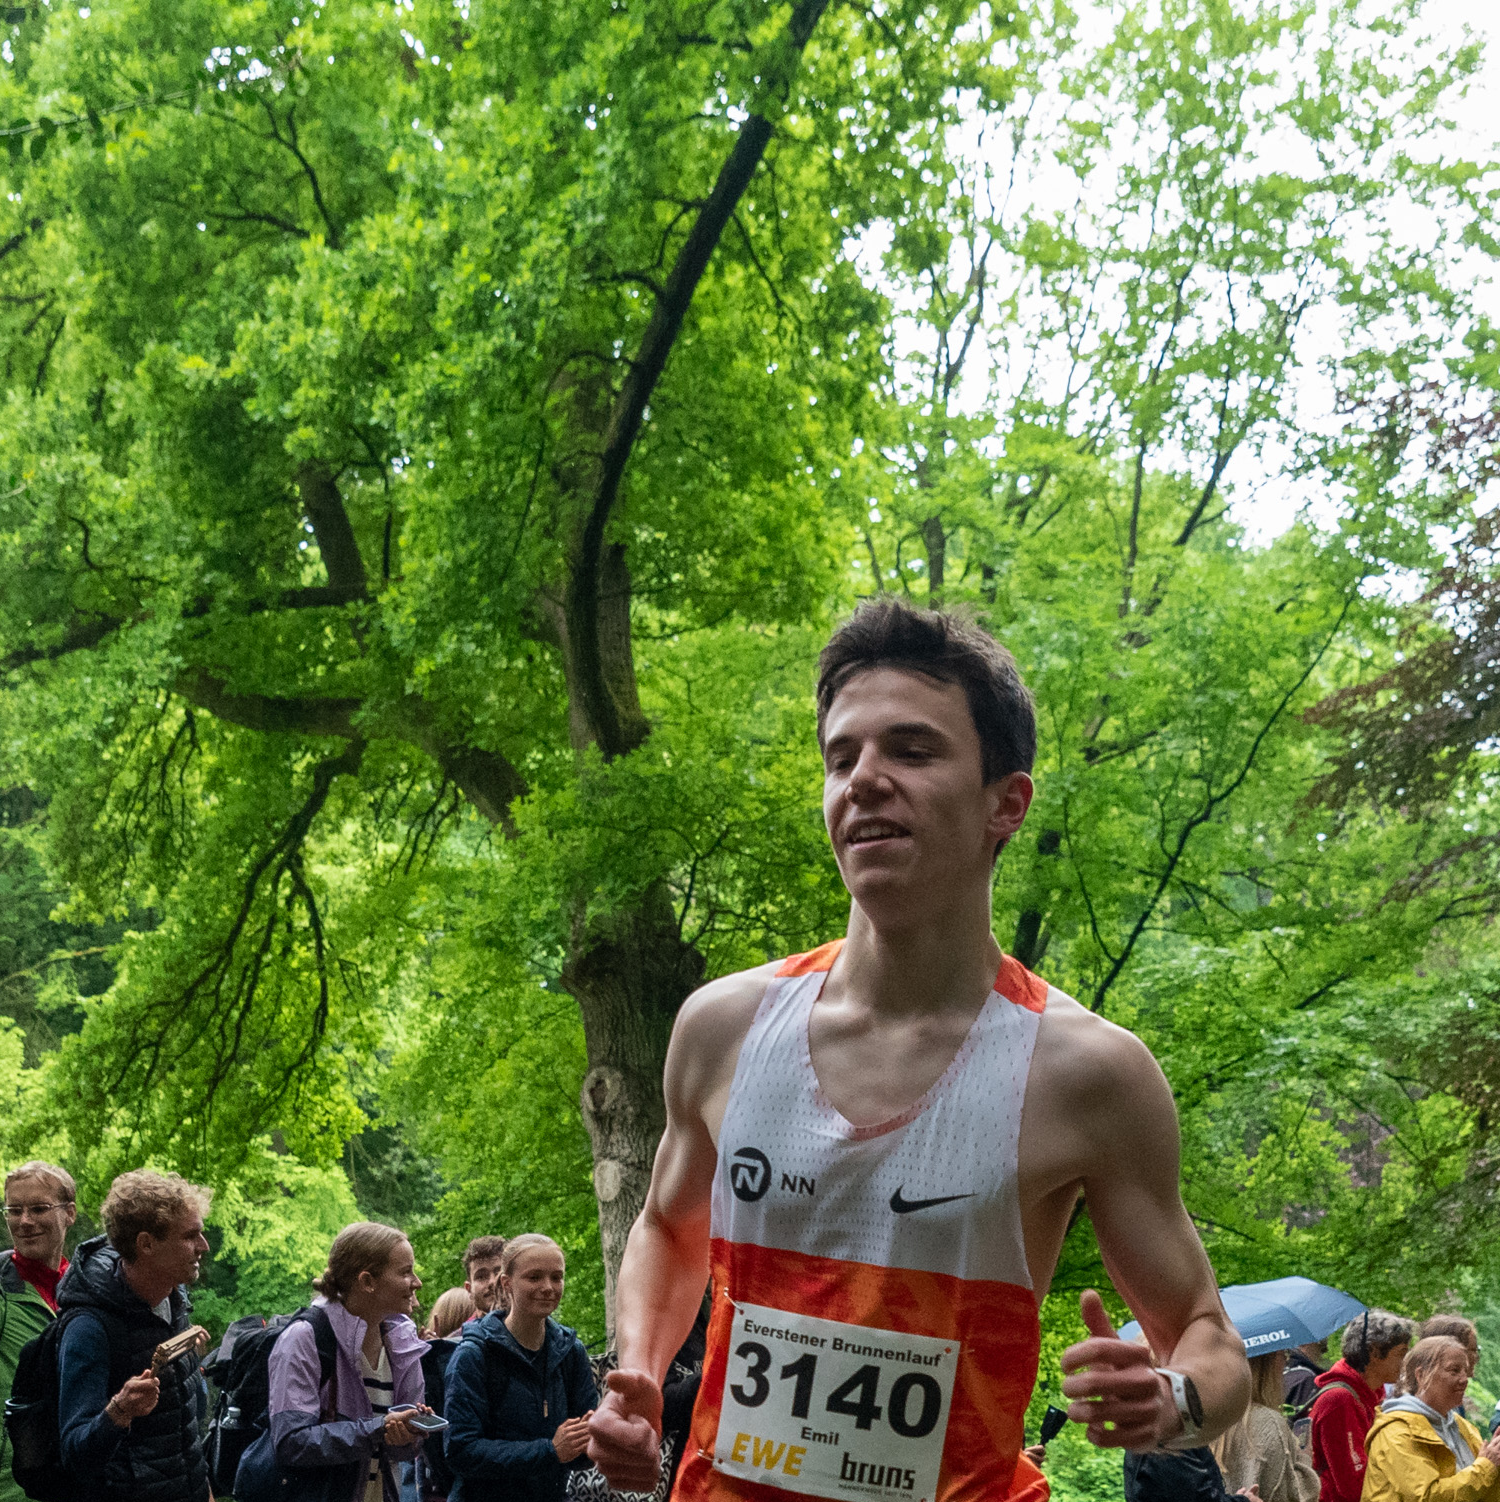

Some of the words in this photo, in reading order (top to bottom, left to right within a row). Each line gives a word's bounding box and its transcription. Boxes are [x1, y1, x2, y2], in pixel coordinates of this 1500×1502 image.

[781, 1172, 816, 1196] NN
[743, 1319, 827, 1348] Everstener
[832, 1338, 941, 1367] Brunnenlauf
[730, 1341, 942, 1438] 3140
[731, 1432, 807, 1477] EWE
[801, 1426, 840, 1446] Emil
[840, 1451, 916, 1490] bruns
